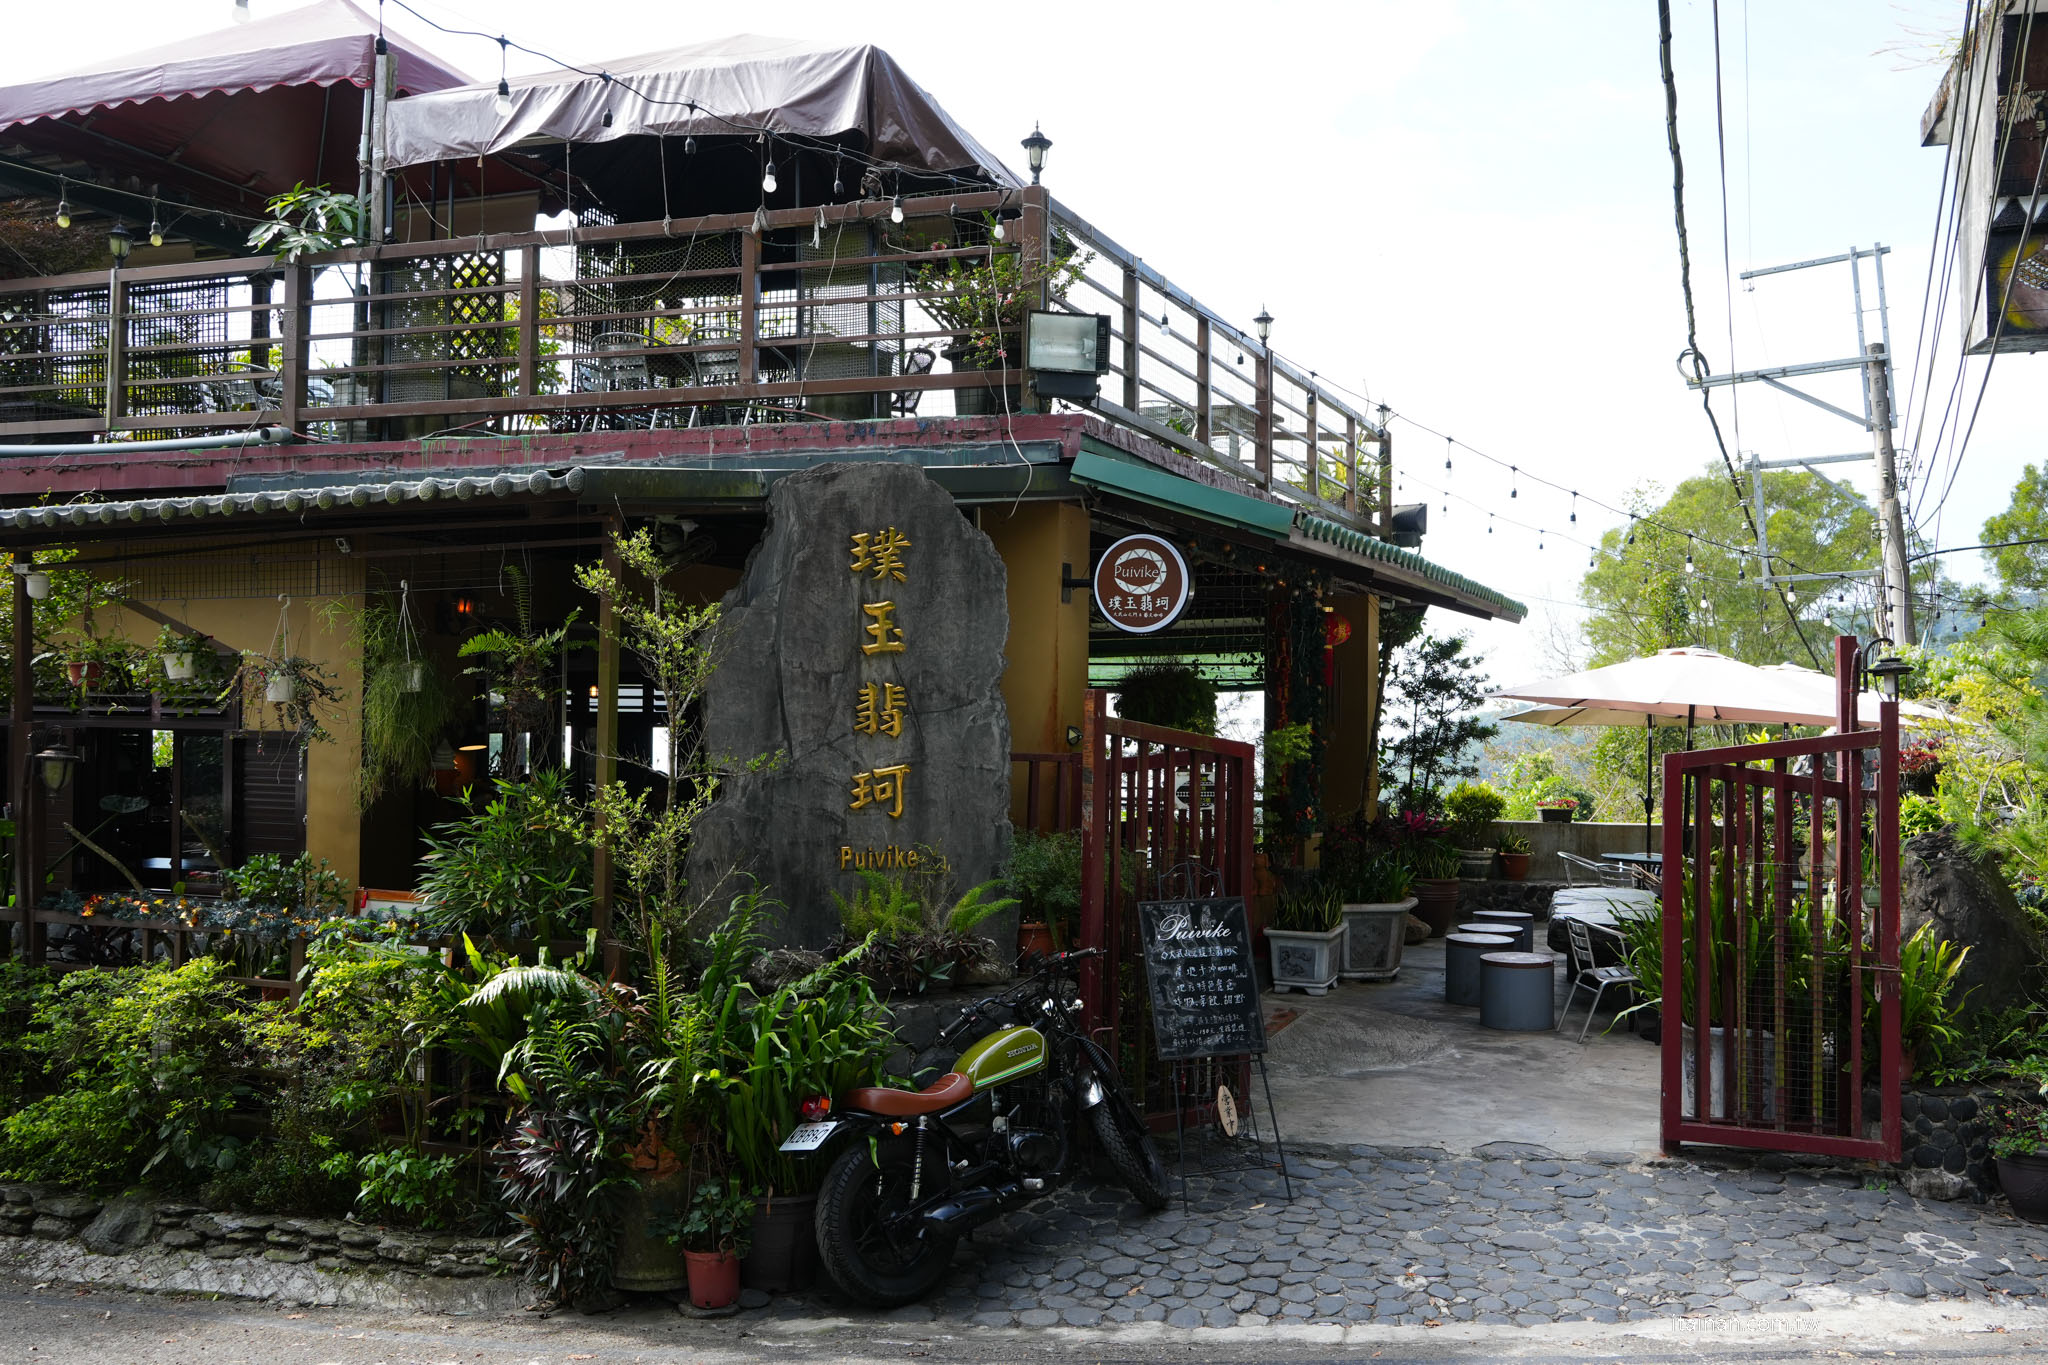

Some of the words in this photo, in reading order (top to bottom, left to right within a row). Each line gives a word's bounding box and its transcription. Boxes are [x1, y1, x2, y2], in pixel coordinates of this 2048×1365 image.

[1114, 564, 1160, 578] Puivike
[1108, 595, 1169, 611] 璞玉翡珂
[849, 526, 912, 818] 璞玉翡珂
[840, 845, 918, 870] Puivike
[1158, 914, 1232, 940] Puivike
[1007, 1044, 1038, 1058] HONDA
